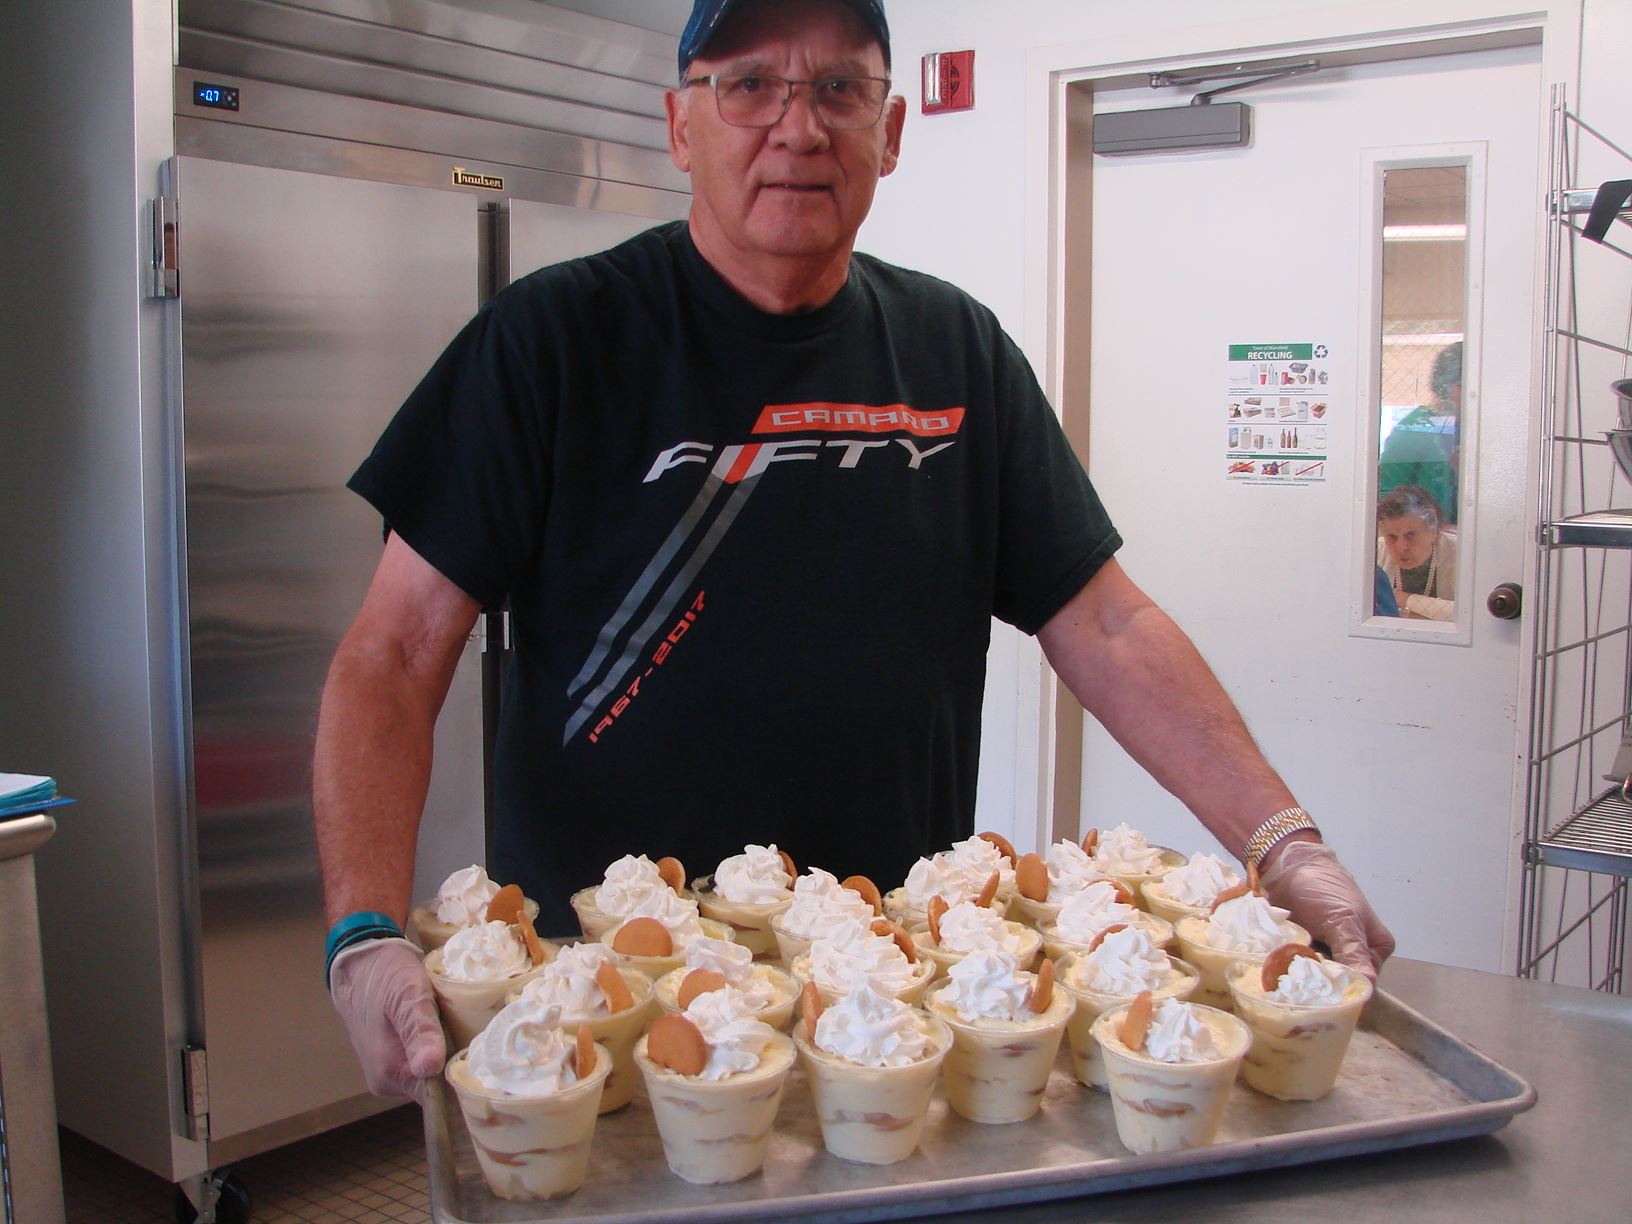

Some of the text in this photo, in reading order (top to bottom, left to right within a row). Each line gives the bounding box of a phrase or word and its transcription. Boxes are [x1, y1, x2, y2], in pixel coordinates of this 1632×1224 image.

[1247, 351, 1292, 360] RECYCLING
[771, 409, 950, 430] CAMARO
[642, 438, 956, 484] FIFTY
